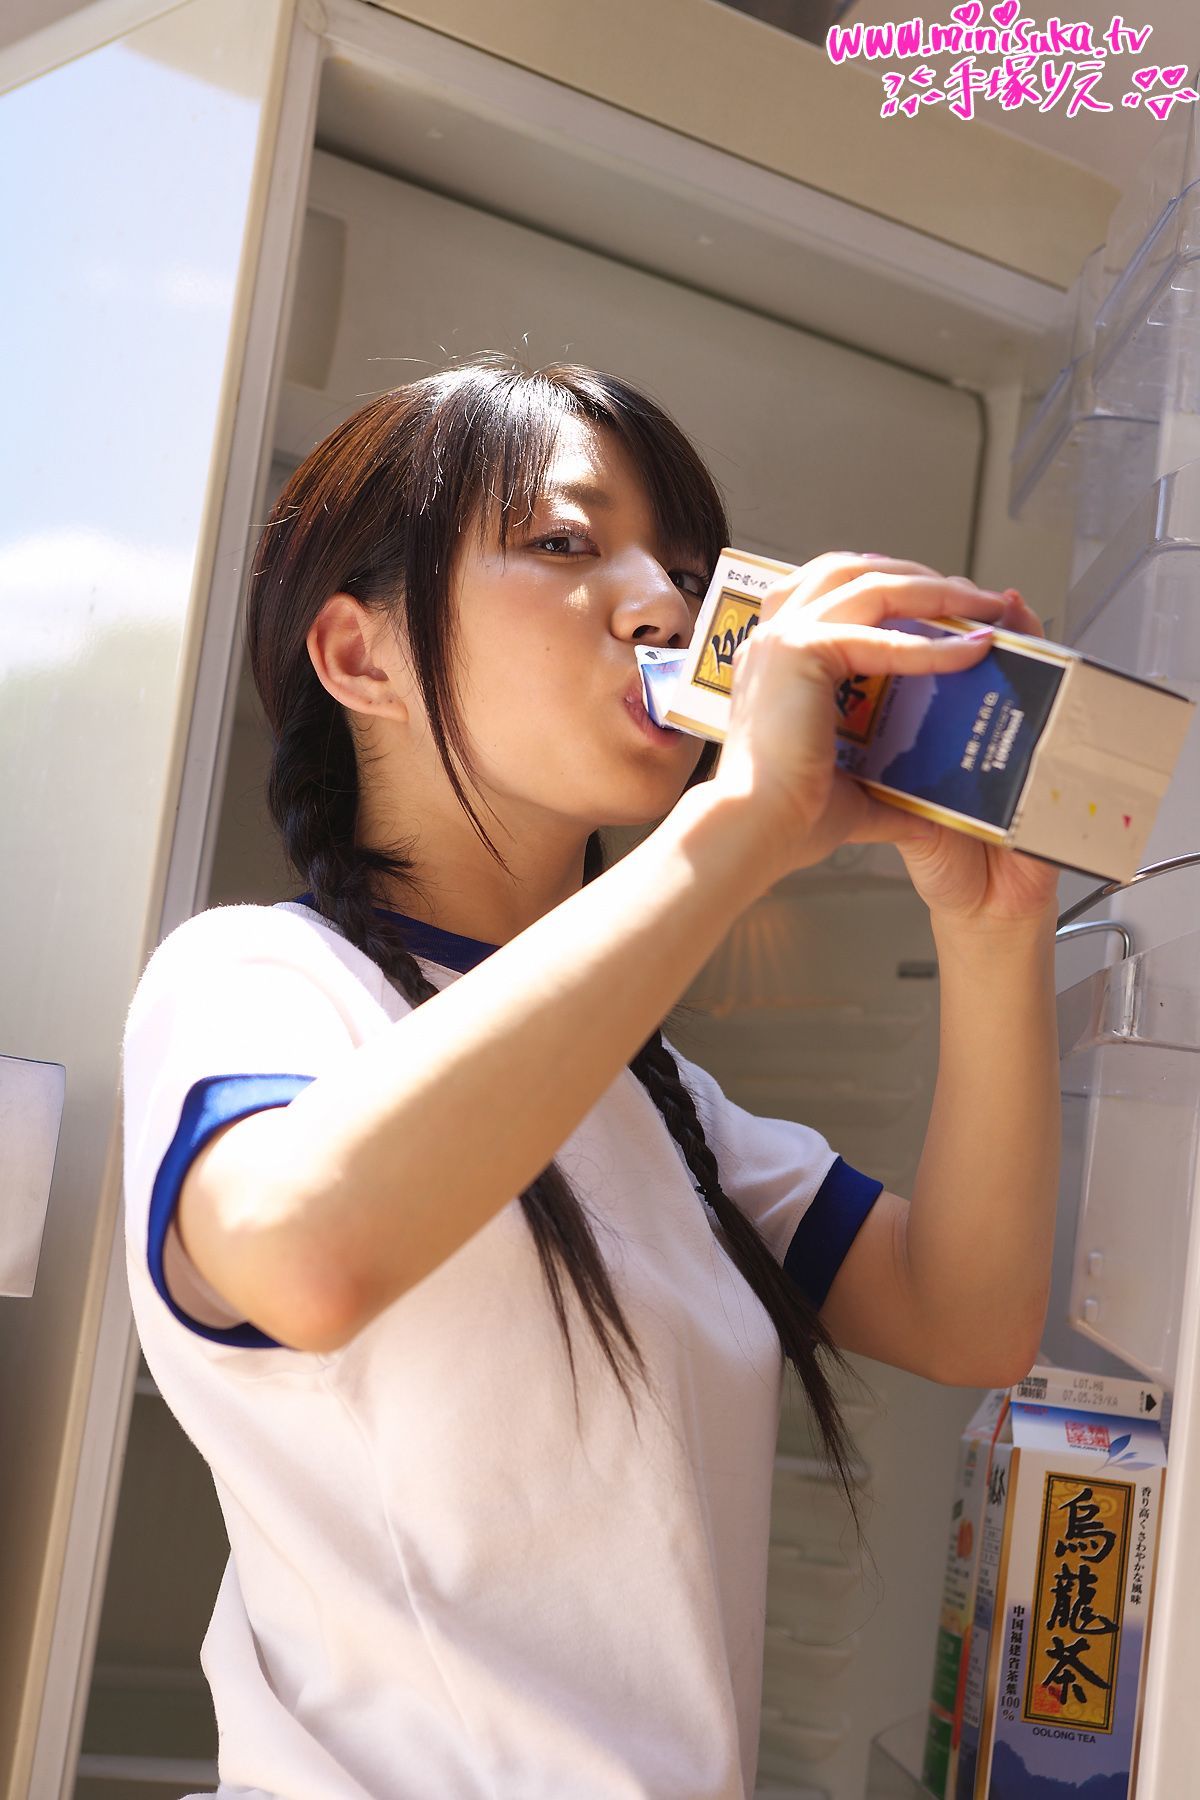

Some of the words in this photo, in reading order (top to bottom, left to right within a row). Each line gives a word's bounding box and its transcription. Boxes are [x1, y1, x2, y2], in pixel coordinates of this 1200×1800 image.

[1041, 1487, 1120, 1705] 烏龍茶
[1131, 1485, 1152, 1605] 香り高くさわやかな風味
[1032, 1726, 1075, 1741] OOLONG
[1078, 1732, 1097, 1744] TEA
